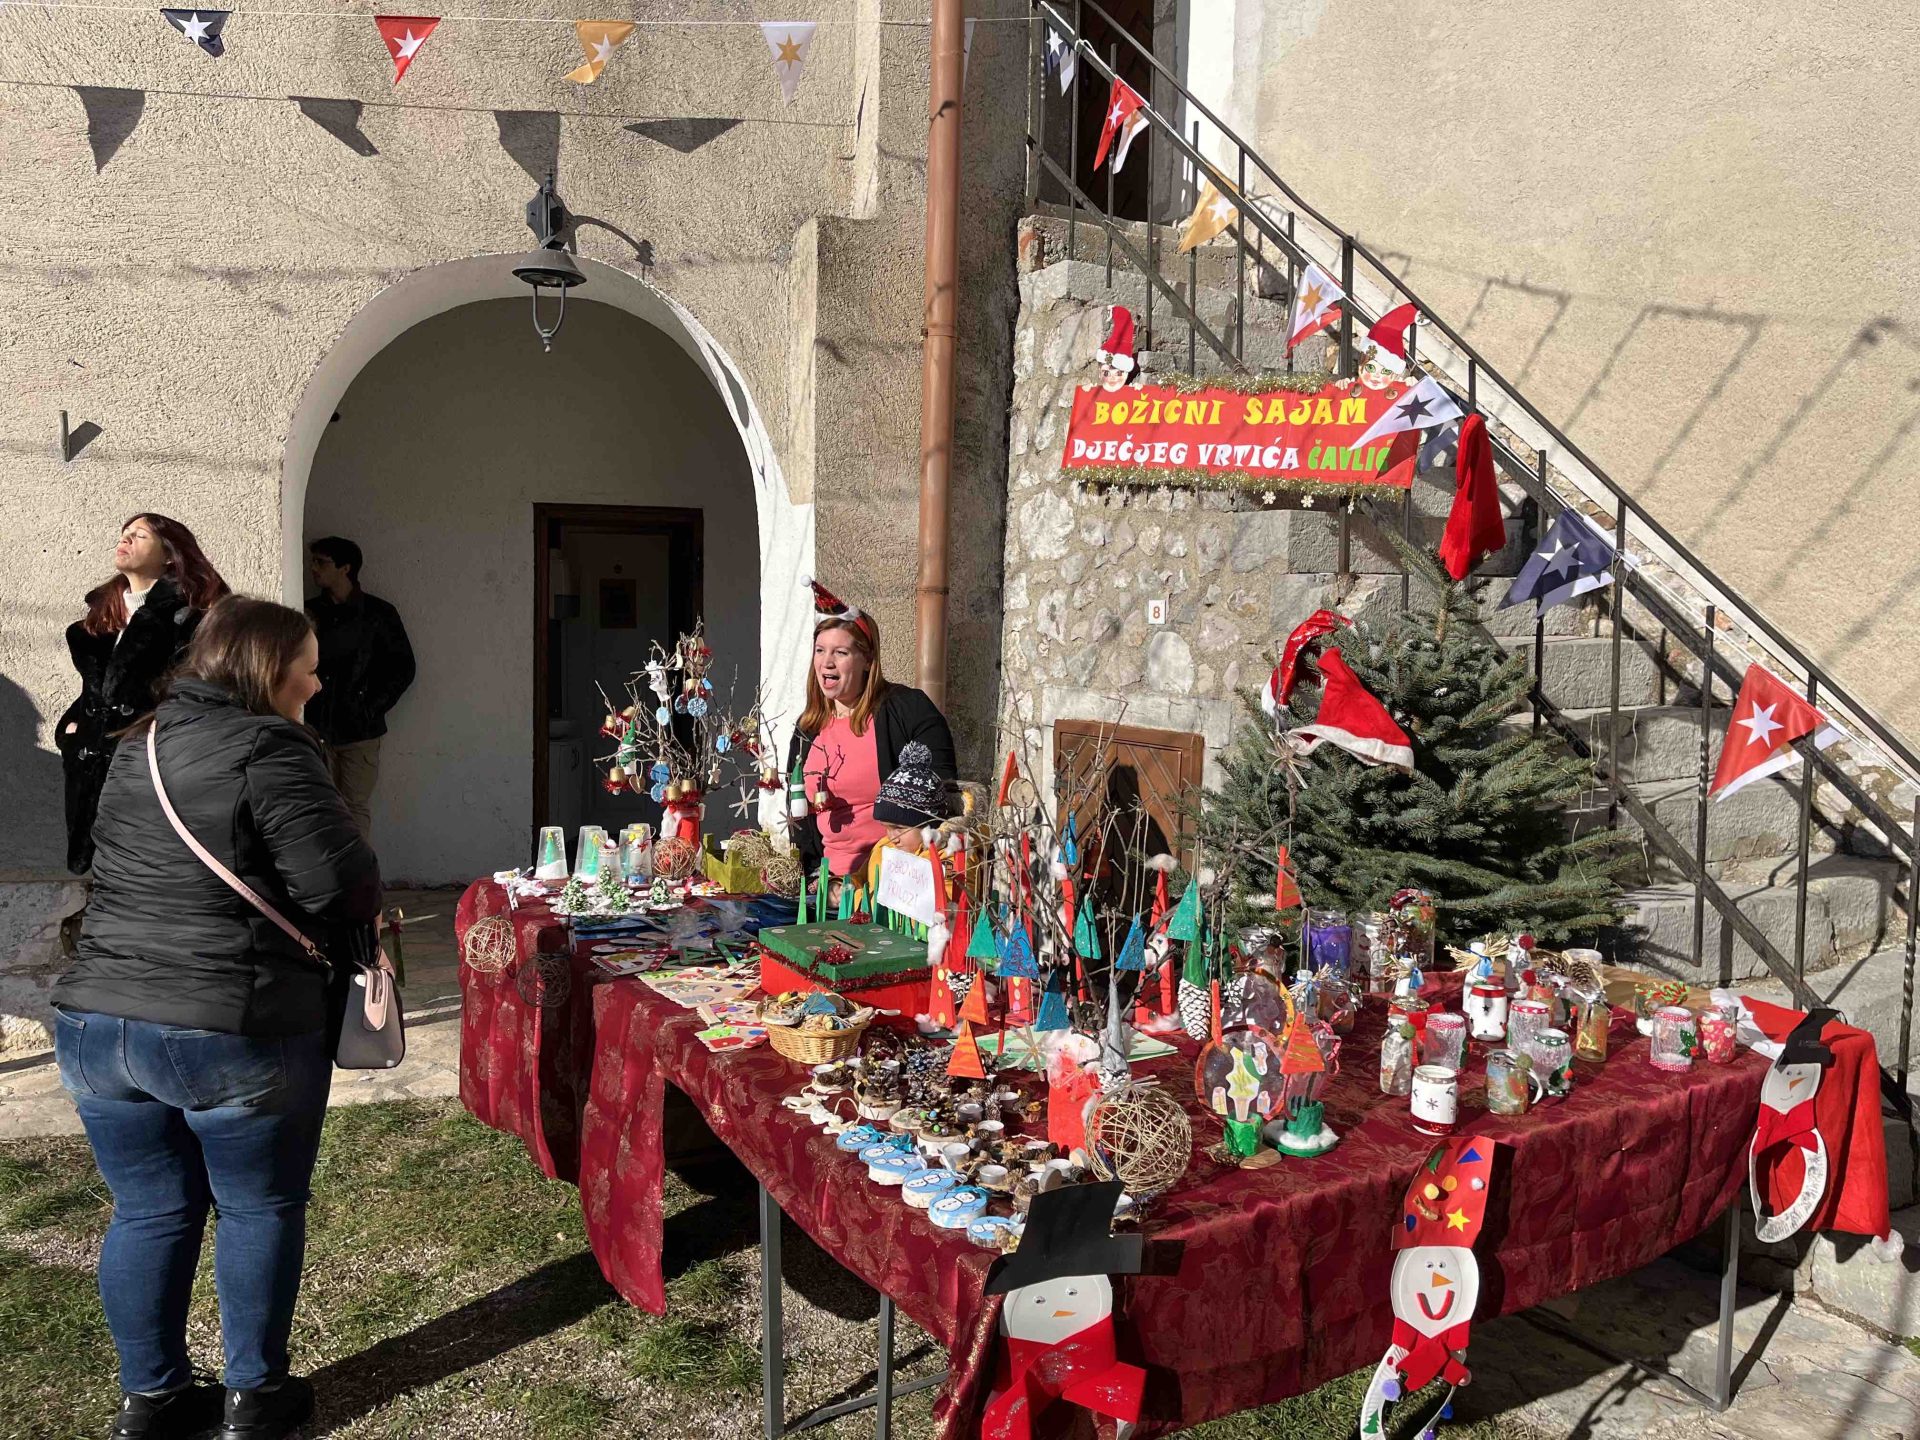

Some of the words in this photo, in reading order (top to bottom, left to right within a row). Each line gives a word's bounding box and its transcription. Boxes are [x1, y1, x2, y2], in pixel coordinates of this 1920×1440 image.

[1243, 397, 1368, 426] SAJAM
[1072, 434, 1189, 464] DJEČJEG
[1197, 437, 1300, 470] VRTIĆA
[1153, 606, 1160, 619] 8
